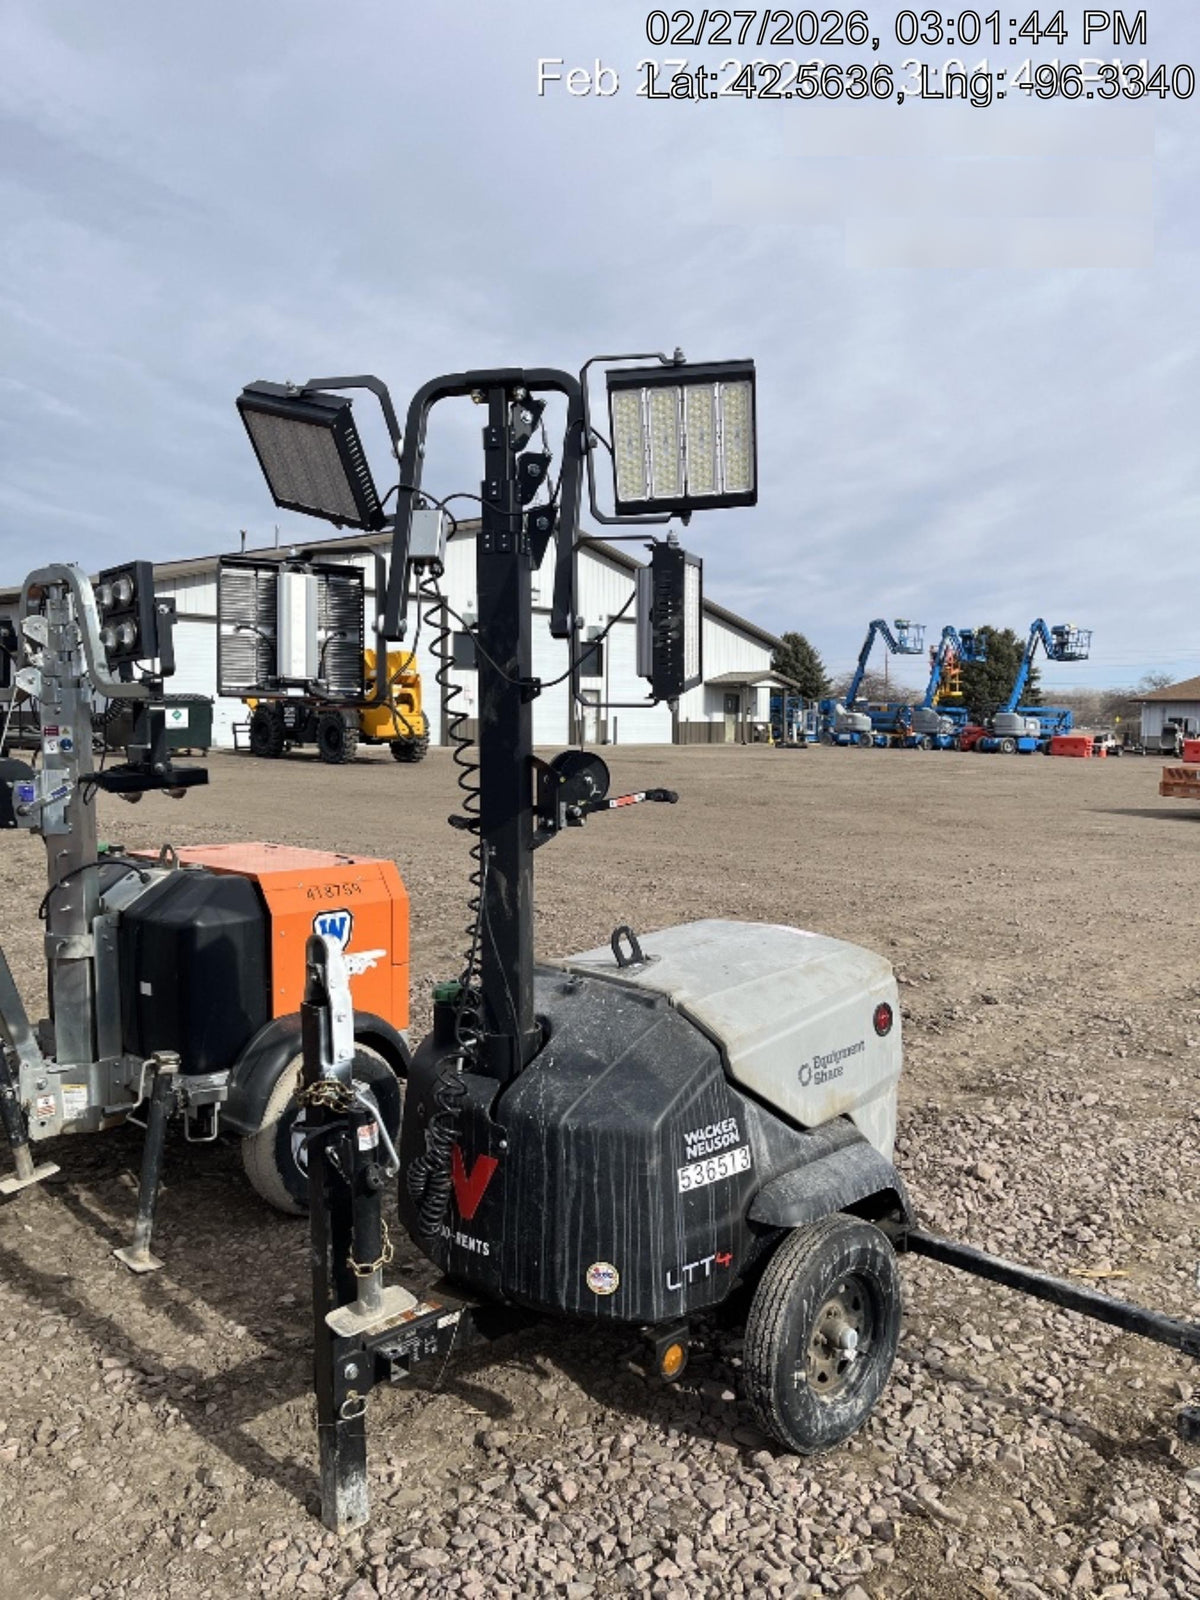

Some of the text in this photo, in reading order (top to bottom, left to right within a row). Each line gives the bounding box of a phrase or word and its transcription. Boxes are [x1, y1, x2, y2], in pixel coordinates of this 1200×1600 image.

[307, 882, 362, 900] 418759
[812, 1040, 865, 1069] Equipment
[813, 1066, 844, 1085] Share
[684, 1117, 738, 1146] WACKER
[686, 1128, 741, 1160] NEUSON
[680, 1147, 749, 1190] 536513
[666, 1251, 733, 1290] LTT4
